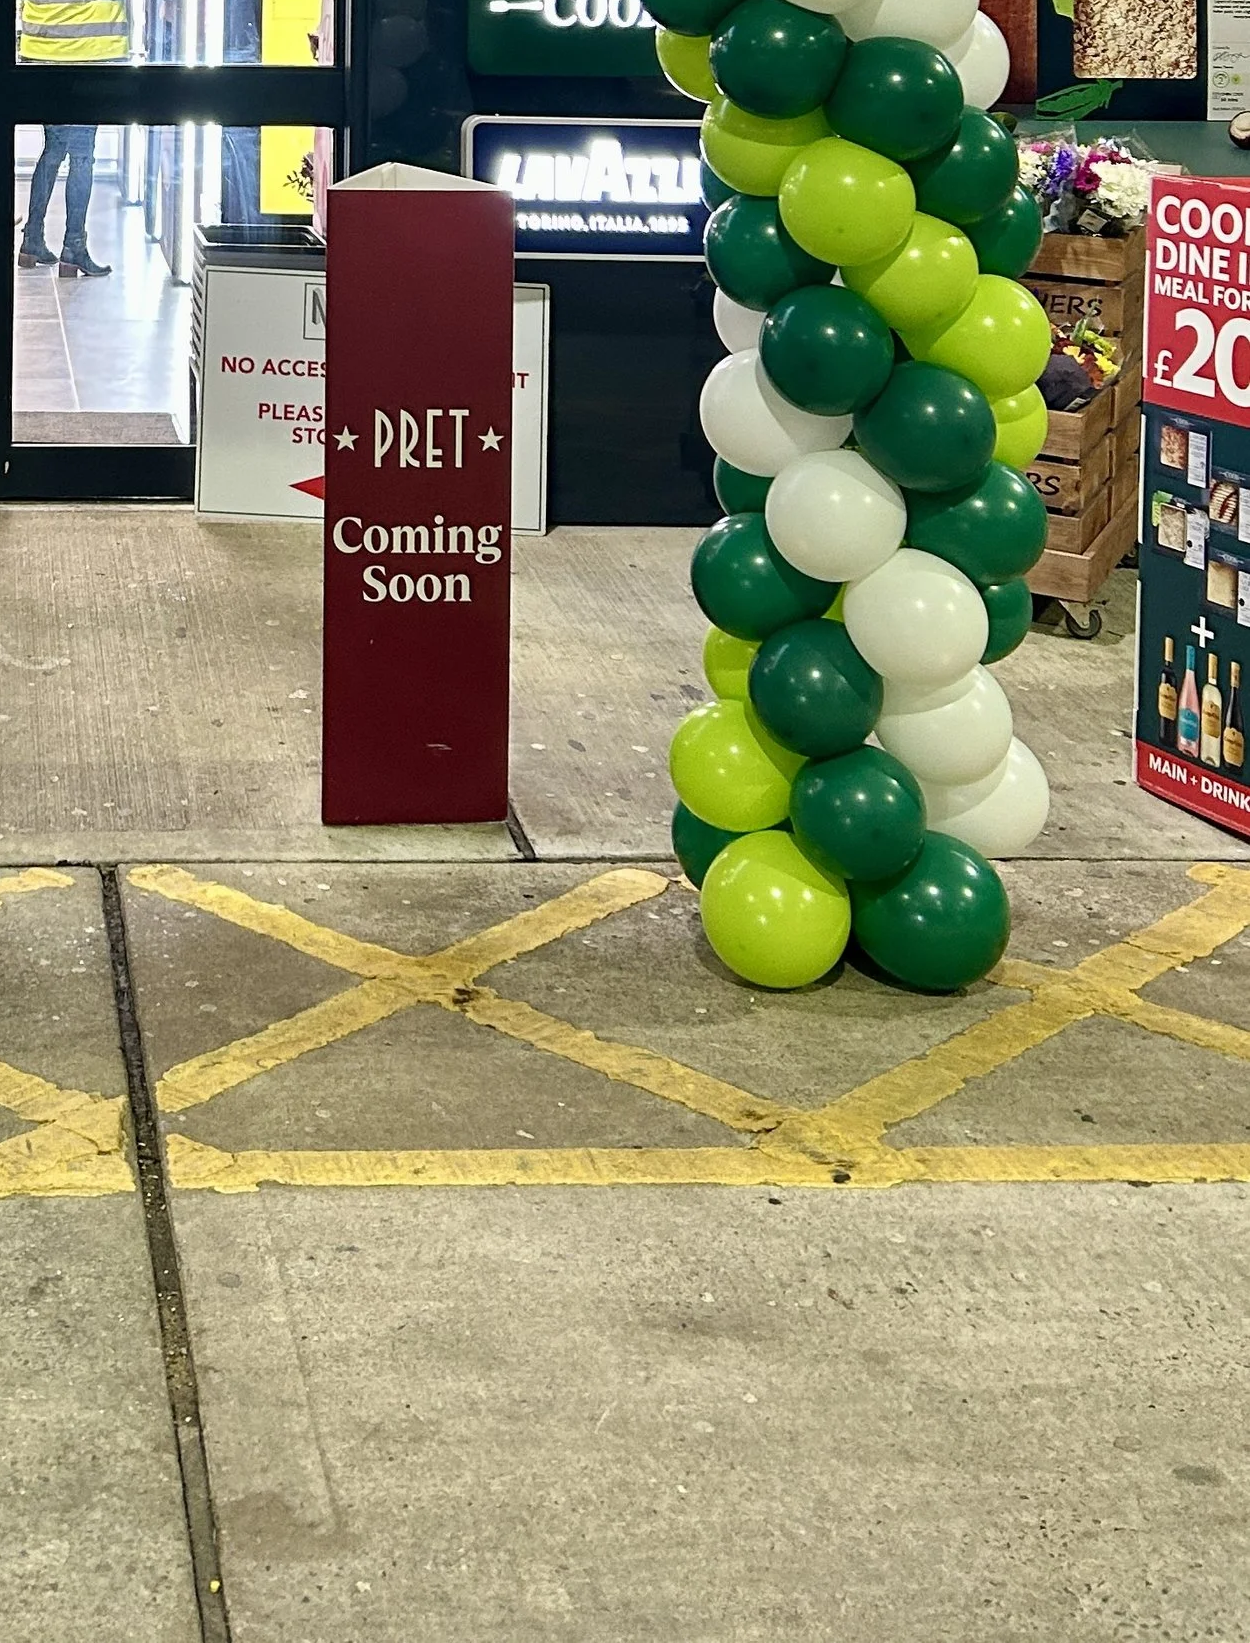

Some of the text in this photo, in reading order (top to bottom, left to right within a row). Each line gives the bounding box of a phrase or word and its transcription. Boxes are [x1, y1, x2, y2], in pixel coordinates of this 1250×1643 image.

[1156, 238, 1250, 285] DINE I
[1154, 274, 1209, 305] MEAL
[221, 356, 255, 374] NO
[1153, 308, 1250, 408] £20
[258, 403, 323, 422] PLEAS
[374, 409, 469, 468] PRET
[333, 514, 503, 564] Coming
[362, 565, 472, 603] Soon
[1149, 752, 1187, 784] MAIN
[1200, 776, 1250, 813] DRINK
